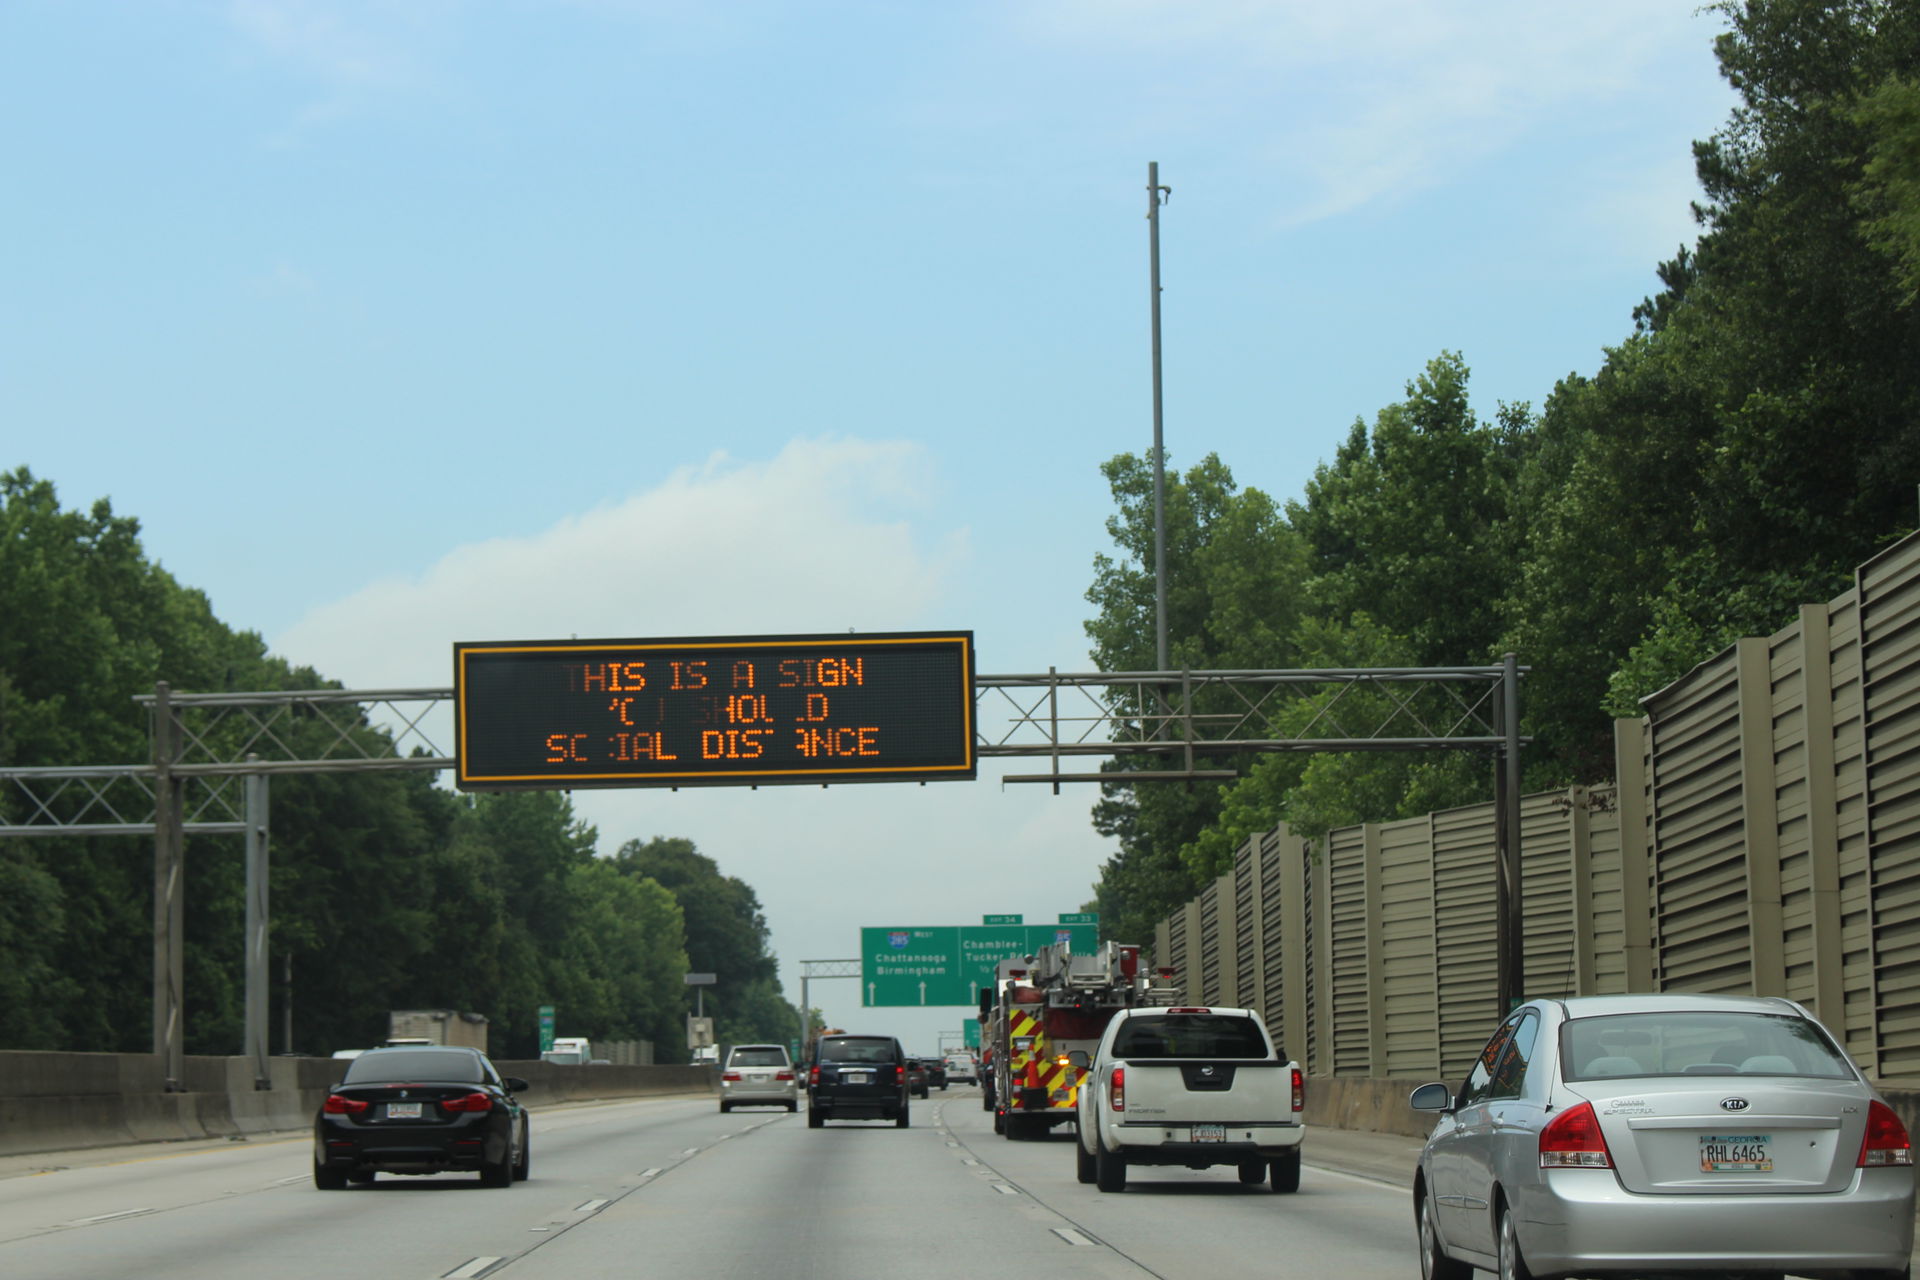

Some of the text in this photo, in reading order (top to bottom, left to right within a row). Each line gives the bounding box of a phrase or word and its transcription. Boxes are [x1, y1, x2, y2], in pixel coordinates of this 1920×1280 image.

[670, 660, 708, 691] IS
[732, 660, 755, 689] A
[778, 657, 864, 687] SIGN
[875, 953, 948, 965] Chattanooga
[965, 952, 1004, 962] Tucker
[876, 966, 946, 977] Birmingham
[1726, 1100, 1745, 1109] KIA
[1727, 1136, 1767, 1144] GEORGIA
[1706, 1144, 1765, 1163] RHL6465
